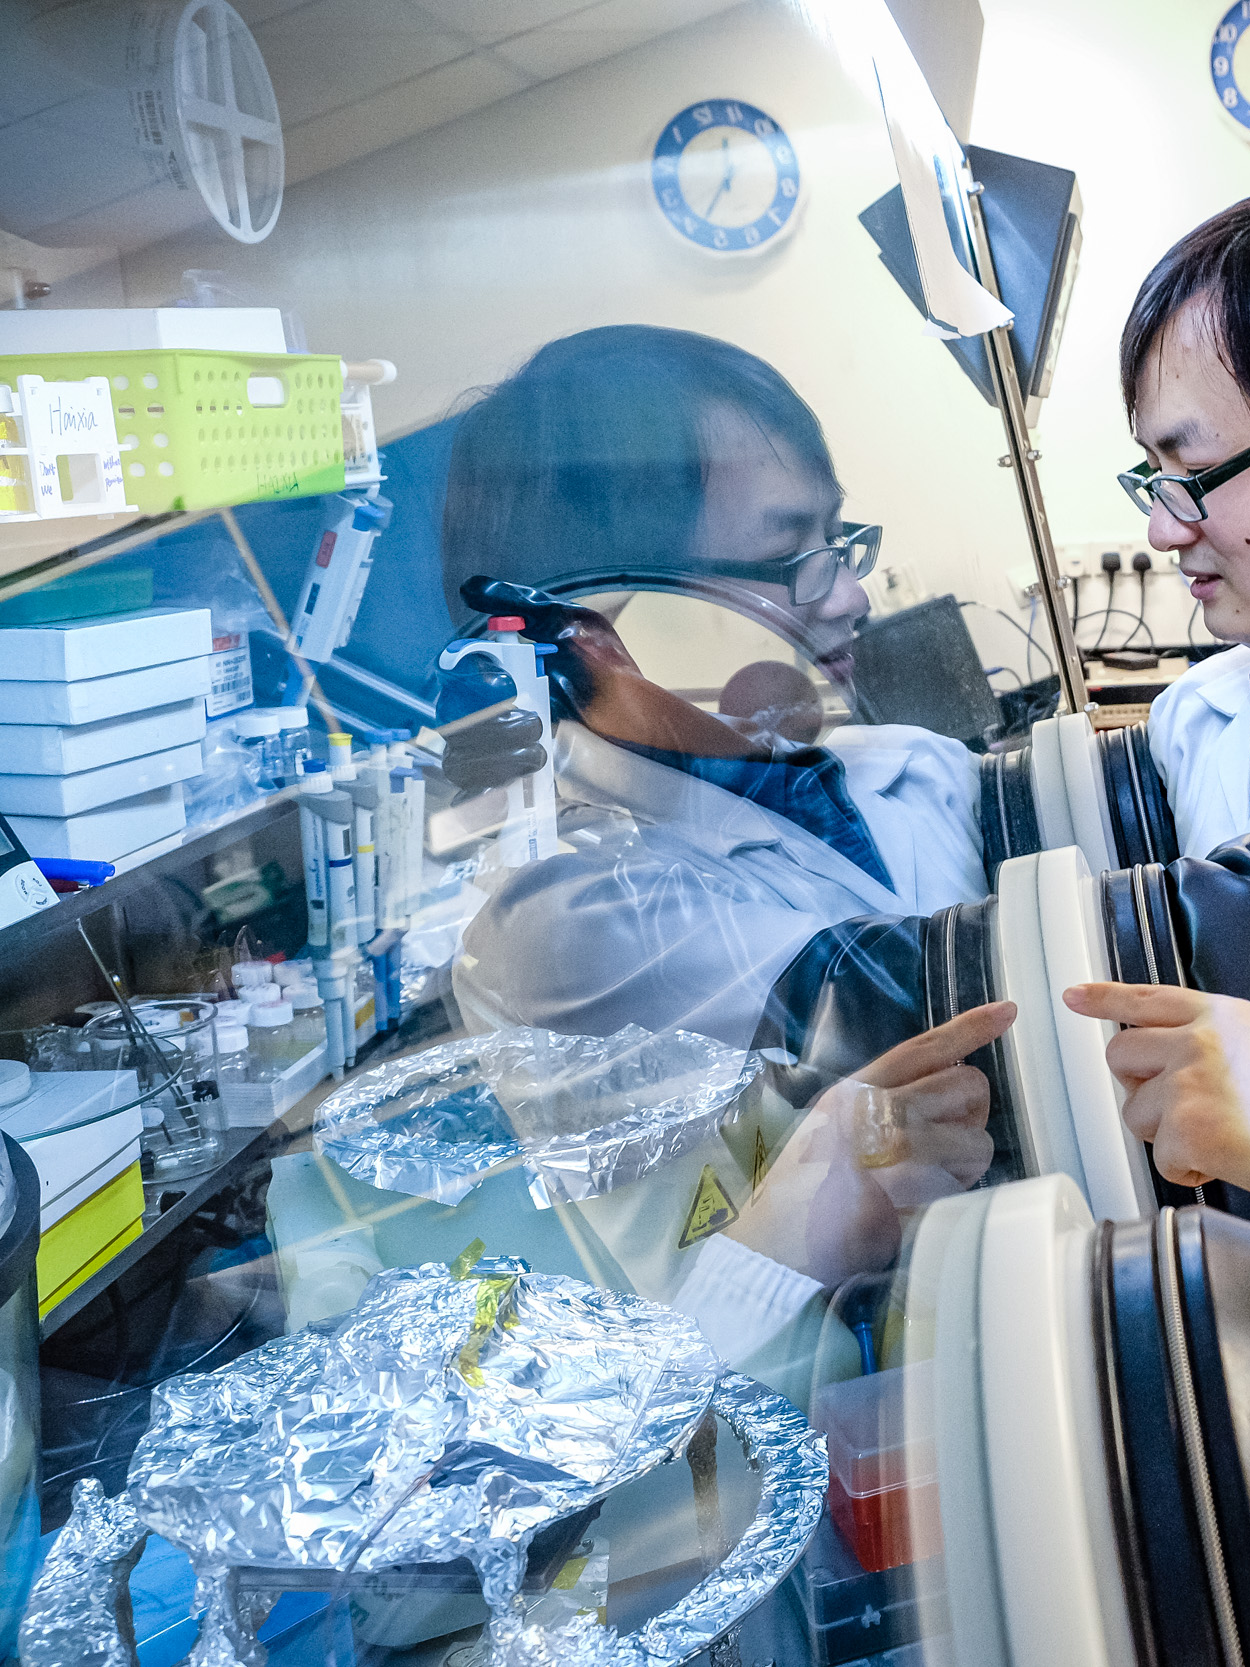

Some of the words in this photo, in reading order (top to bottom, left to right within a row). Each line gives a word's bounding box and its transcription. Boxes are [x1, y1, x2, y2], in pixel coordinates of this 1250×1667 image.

[1219, 23, 1238, 43] 10
[1213, 56, 1229, 77] 9
[1222, 87, 1238, 108] 8
[49, 396, 98, 436] Haixia
